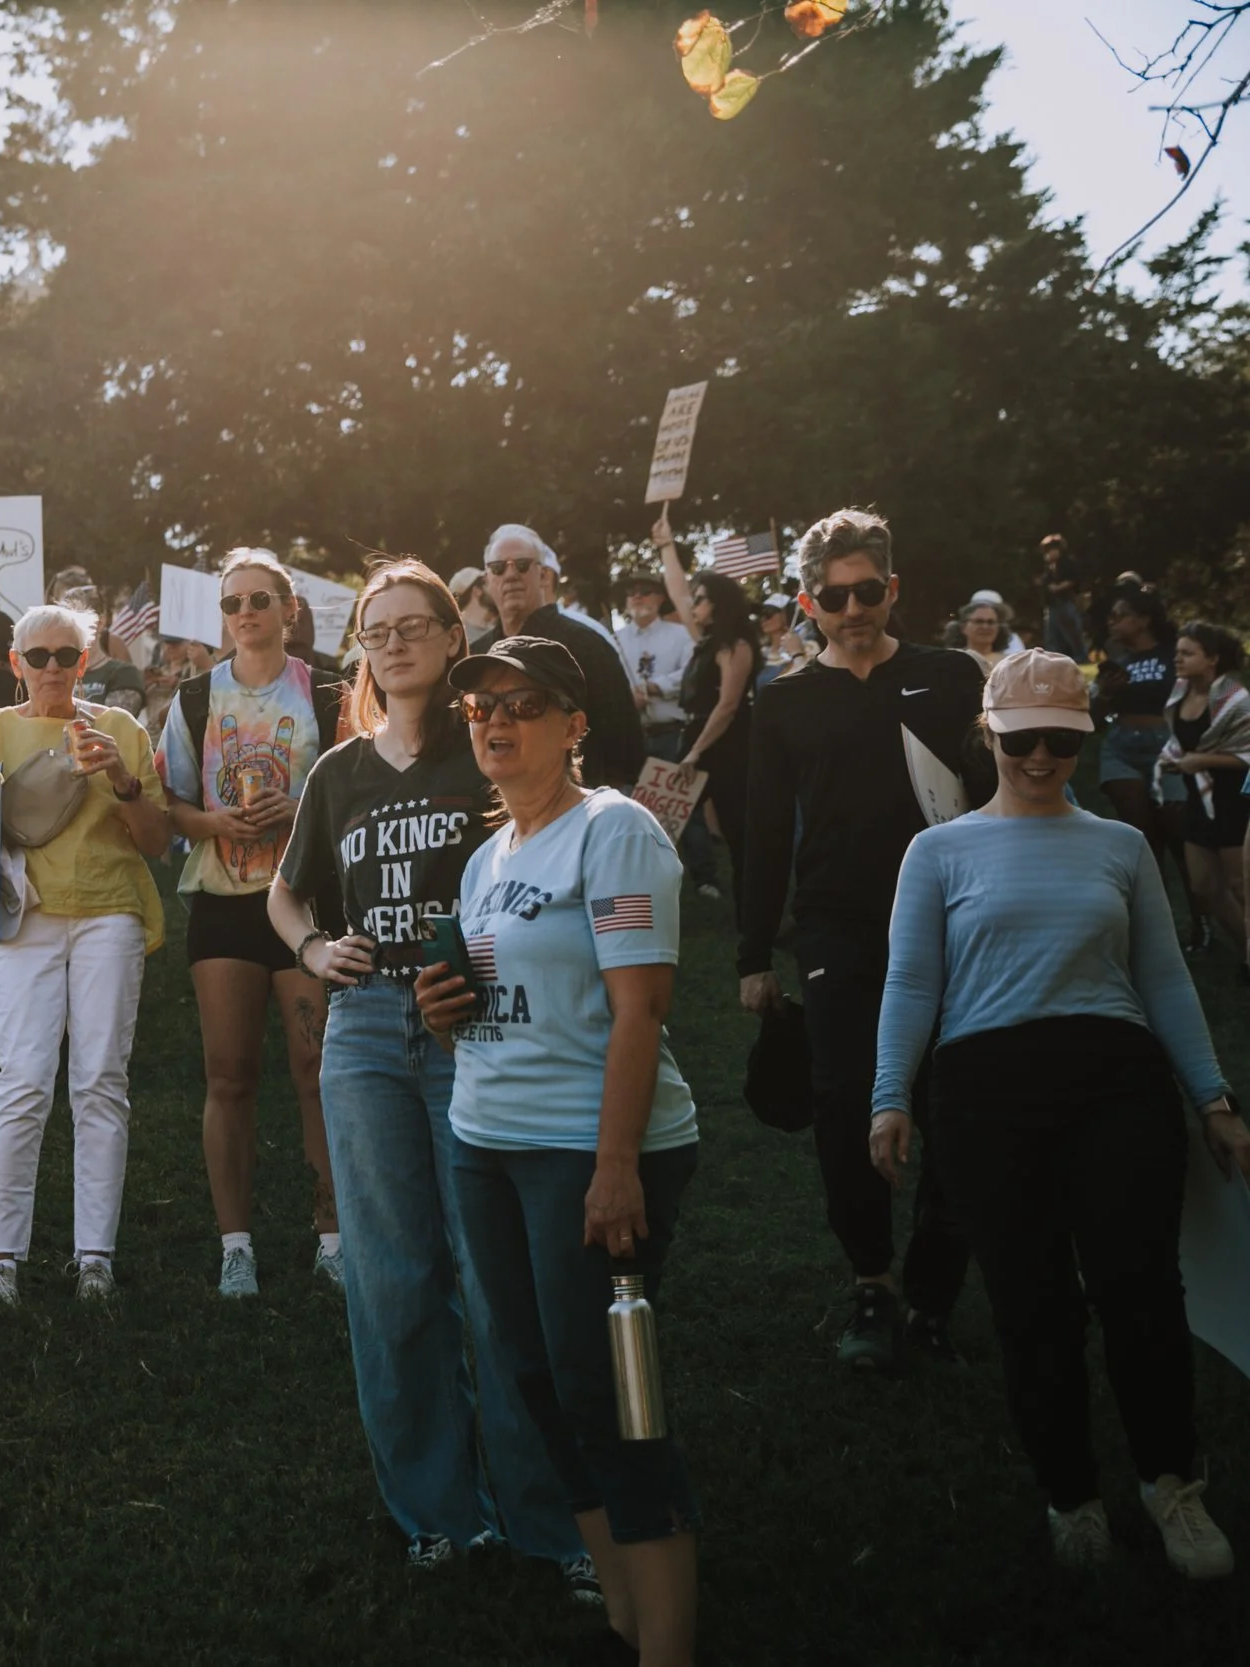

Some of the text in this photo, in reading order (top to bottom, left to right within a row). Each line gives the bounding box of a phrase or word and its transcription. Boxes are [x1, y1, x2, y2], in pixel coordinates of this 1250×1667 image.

[632, 785, 693, 820] TARGETS
[340, 811, 469, 873] NO KINGS
[380, 860, 412, 899] IN
[475, 880, 552, 921] KINGS
[475, 985, 531, 1024] RICA
